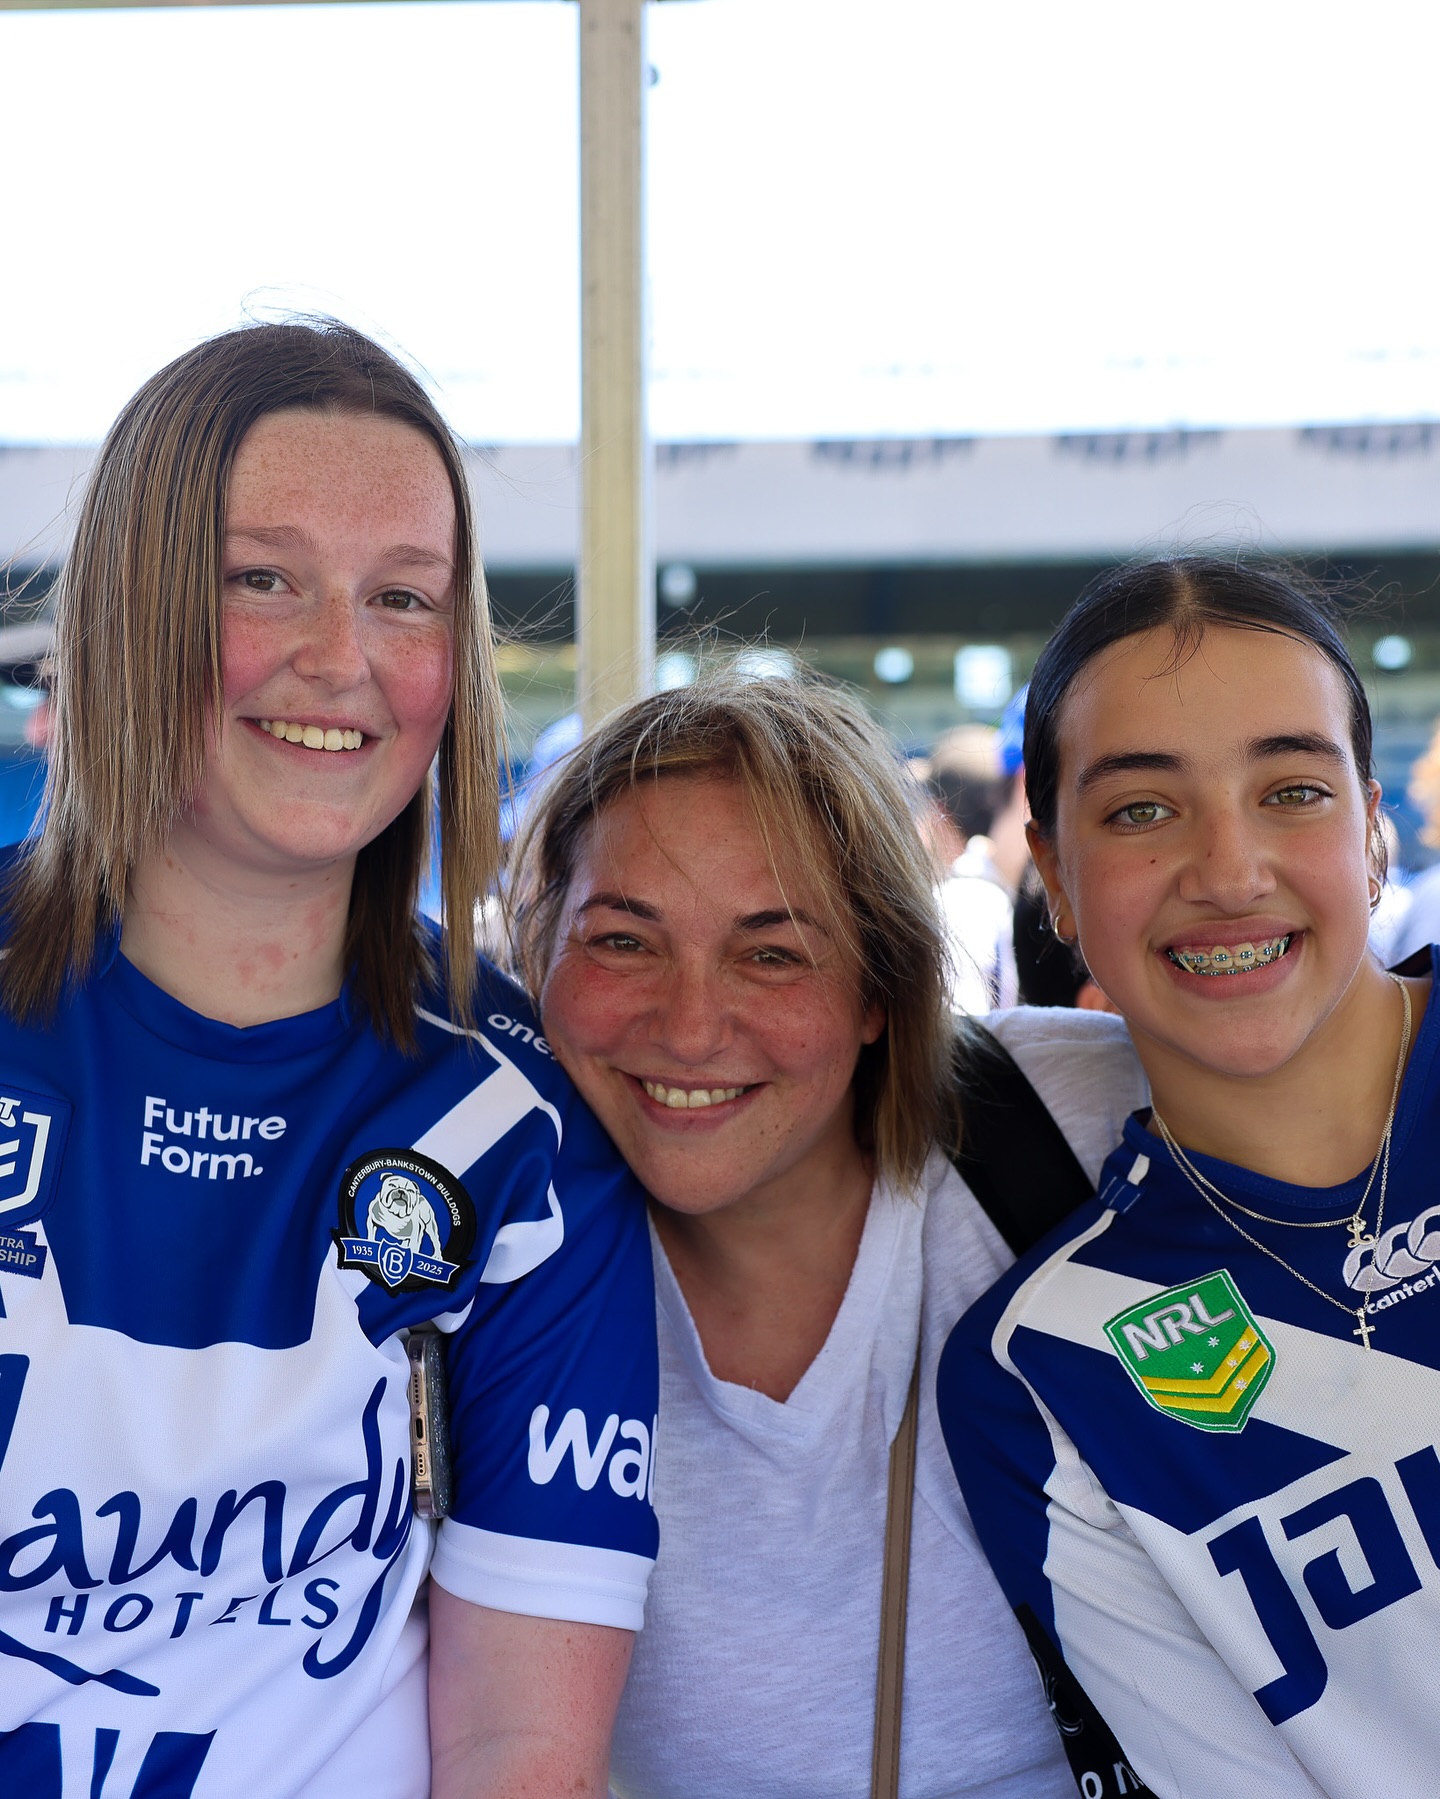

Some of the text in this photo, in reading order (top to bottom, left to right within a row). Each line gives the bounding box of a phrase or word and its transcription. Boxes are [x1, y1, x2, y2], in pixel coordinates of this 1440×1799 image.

[144, 1096, 287, 1141] Future
[140, 1131, 264, 1180] Form.
[348, 1158, 461, 1227] CANTERBURY-BANKSTOWN BULLDOGS
[352, 1245, 374, 1256] 1935
[416, 1260, 444, 1275] 2025
[1121, 1292, 1237, 1361] NRL
[44, 1577, 340, 1639] HOTELS
